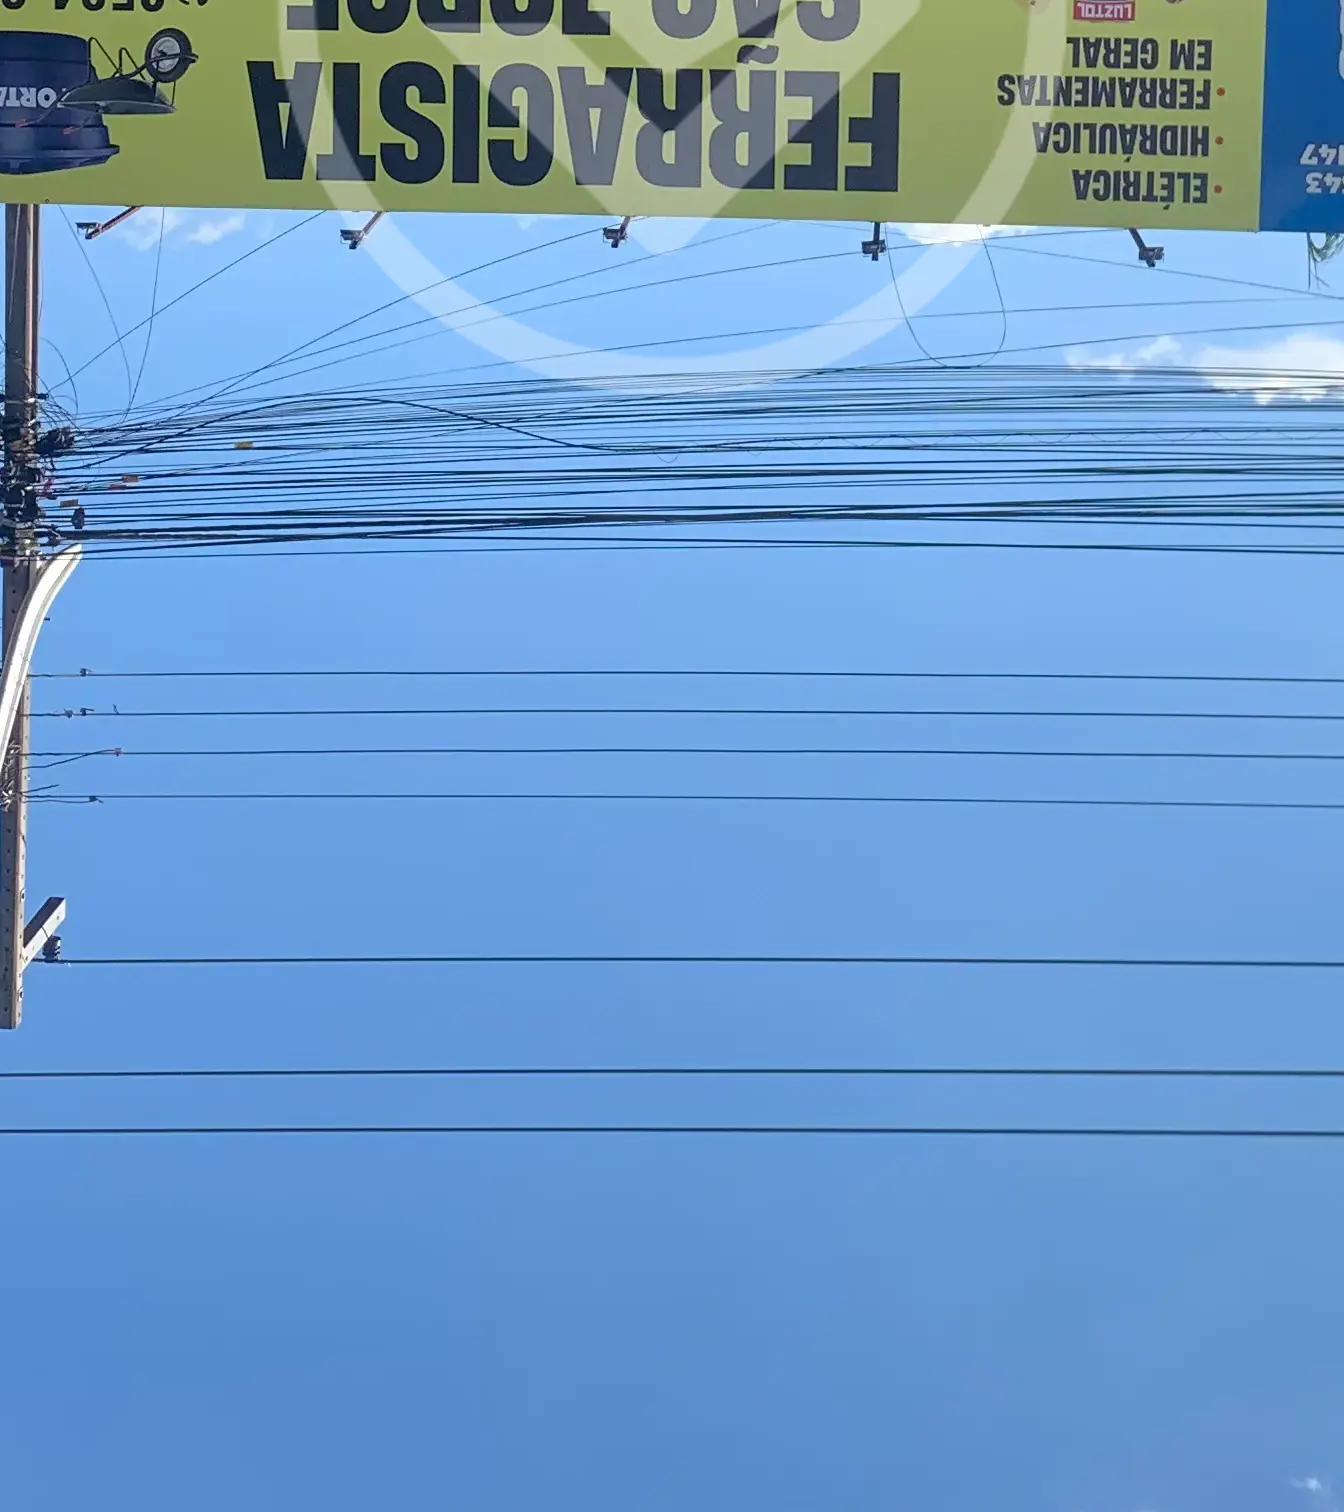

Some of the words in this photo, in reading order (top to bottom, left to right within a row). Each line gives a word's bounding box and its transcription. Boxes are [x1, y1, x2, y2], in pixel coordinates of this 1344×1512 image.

[1077, 3, 1133, 20] LUZTOL
[1066, 37, 1159, 70] GERAL
[1169, 38, 1213, 71] EM
[996, 74, 1212, 110] FERRAMENTAS
[246, 61, 900, 192] FERRAGISTA
[1032, 122, 1210, 162] HIDRÁULICA
[1072, 169, 1208, 210] ELÉTRICA
